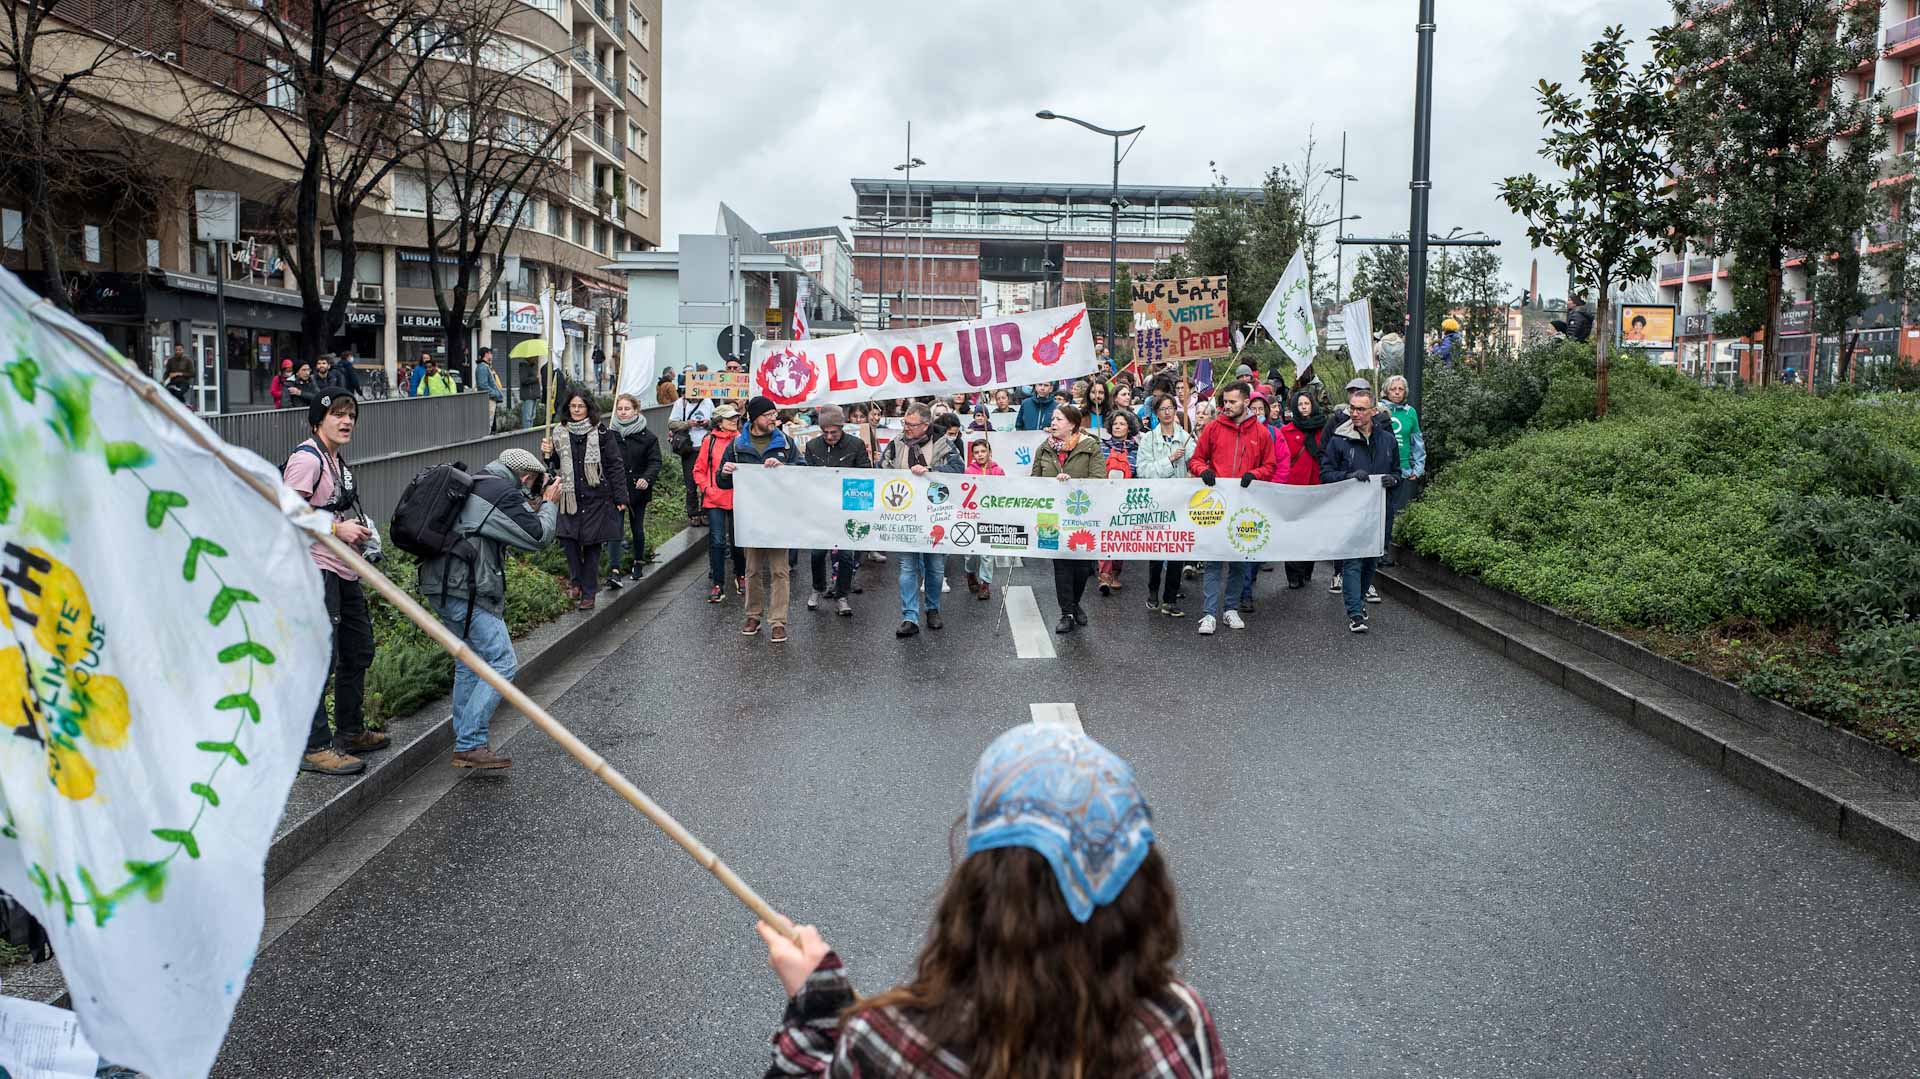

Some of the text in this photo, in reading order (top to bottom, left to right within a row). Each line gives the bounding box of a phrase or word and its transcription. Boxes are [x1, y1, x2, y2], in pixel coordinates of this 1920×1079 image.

[1132, 278, 1227, 303] NUCLEAIRE
[347, 313, 376, 324] TAPAS
[1169, 303, 1214, 322] VERTE
[403, 316, 441, 326] LE BLAH
[826, 322, 1023, 392] LOOK UP
[980, 495, 1055, 509] GREENPEACE
[956, 510, 981, 520] attac
[1110, 510, 1177, 527] ALTERNATIBA
[979, 523, 1018, 534] extinction
[989, 533, 1027, 545] rebellion
[1101, 530, 1195, 542] FRANCE NATURE
[1101, 542, 1195, 552] ENVIRONNEMENT
